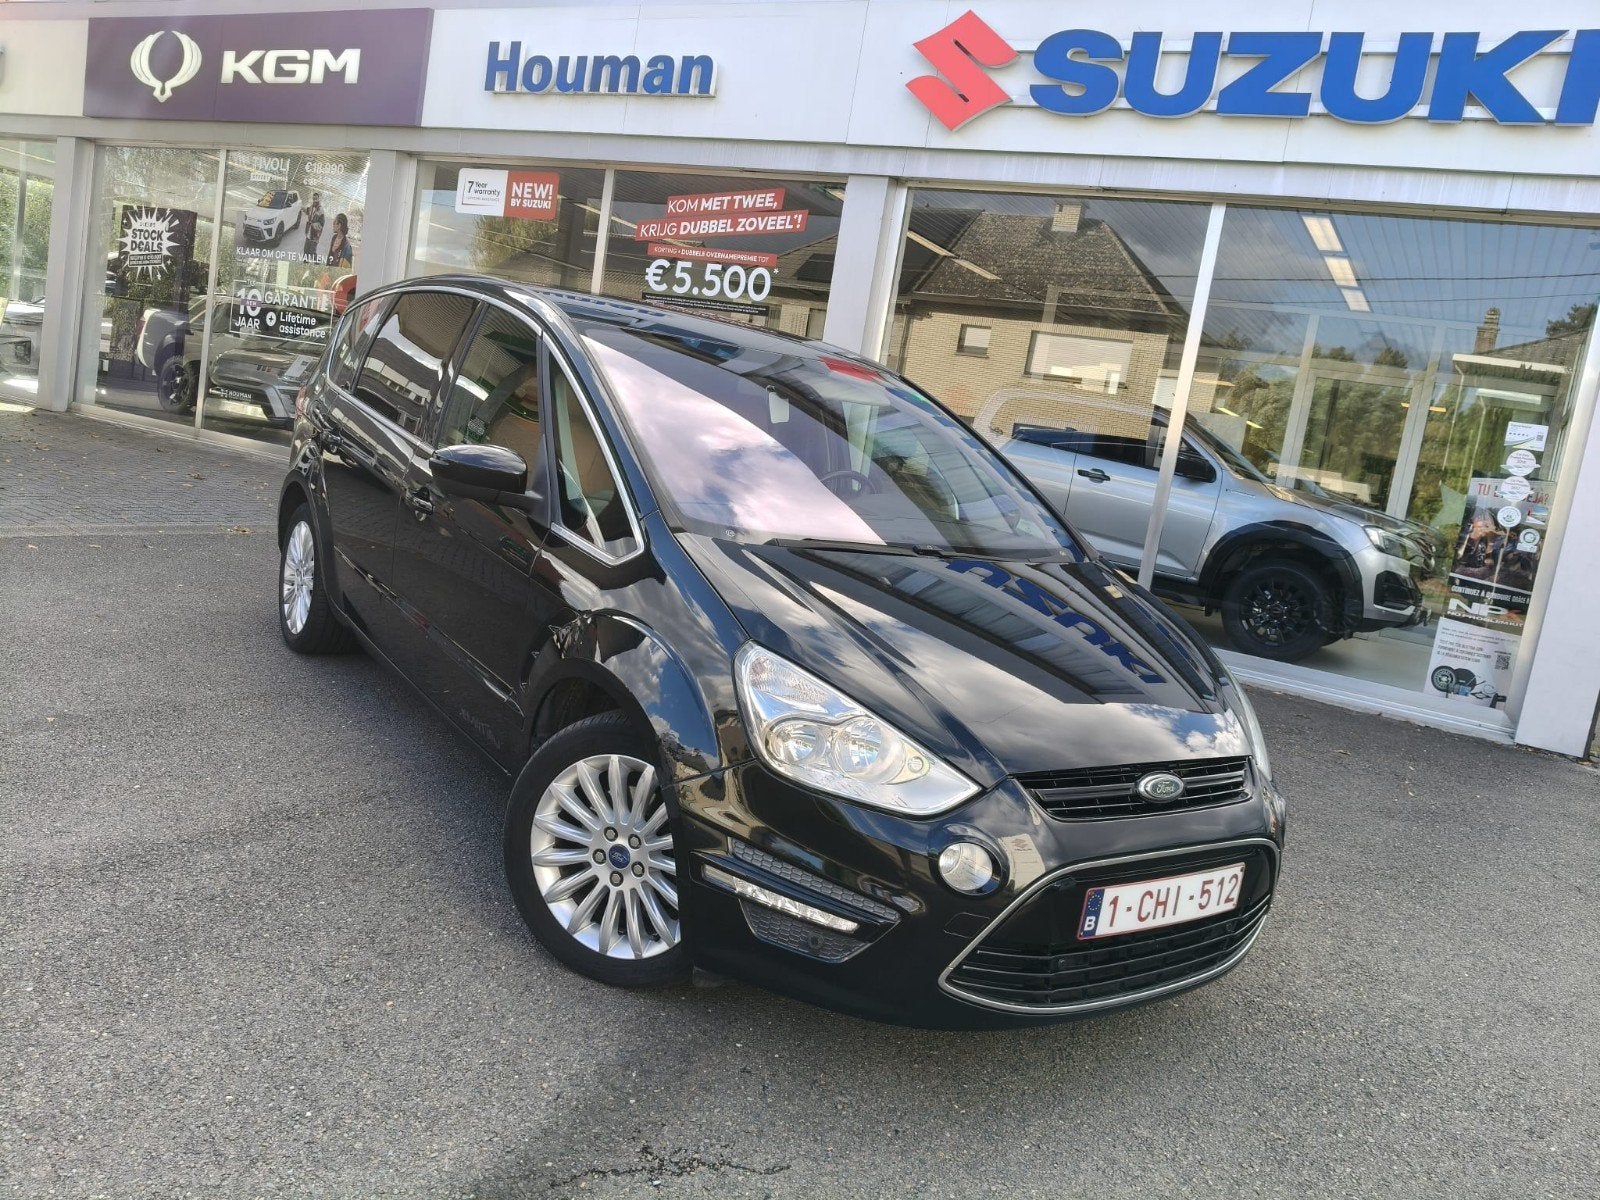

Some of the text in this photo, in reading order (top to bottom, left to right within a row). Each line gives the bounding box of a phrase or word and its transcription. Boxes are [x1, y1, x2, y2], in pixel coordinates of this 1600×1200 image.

[220, 48, 361, 85] KGM
[484, 41, 716, 97] Houman
[1029, 29, 1600, 126] SUZUKI
[467, 181, 474, 194] 7
[475, 181, 488, 189] Year
[511, 182, 554, 200] NEW!
[474, 188, 500, 197] warranty
[510, 199, 521, 207] BY
[522, 199, 552, 210] SUZUKI
[667, 192, 778, 213] KOM MET TWEE,
[131, 228, 164, 241] STOCK
[639, 222, 677, 238] KRIJG
[679, 218, 734, 235] DUBBEL
[130, 240, 163, 252] DEALS
[654, 246, 678, 255] KORTING
[236, 246, 260, 257] KLAAR
[261, 249, 274, 258] OM
[275, 250, 286, 259] OP
[288, 252, 296, 261] TE
[298, 253, 328, 264] VALLEN
[236, 288, 262, 317] 10
[264, 291, 329, 312] GARANTIE
[234, 317, 260, 330] JAAR
[280, 311, 317, 326] Lifetime
[279, 324, 326, 338] assistance
[1478, 483, 1491, 495] TU
[1156, 781, 1175, 793] Ford
[1083, 915, 1096, 931] B
